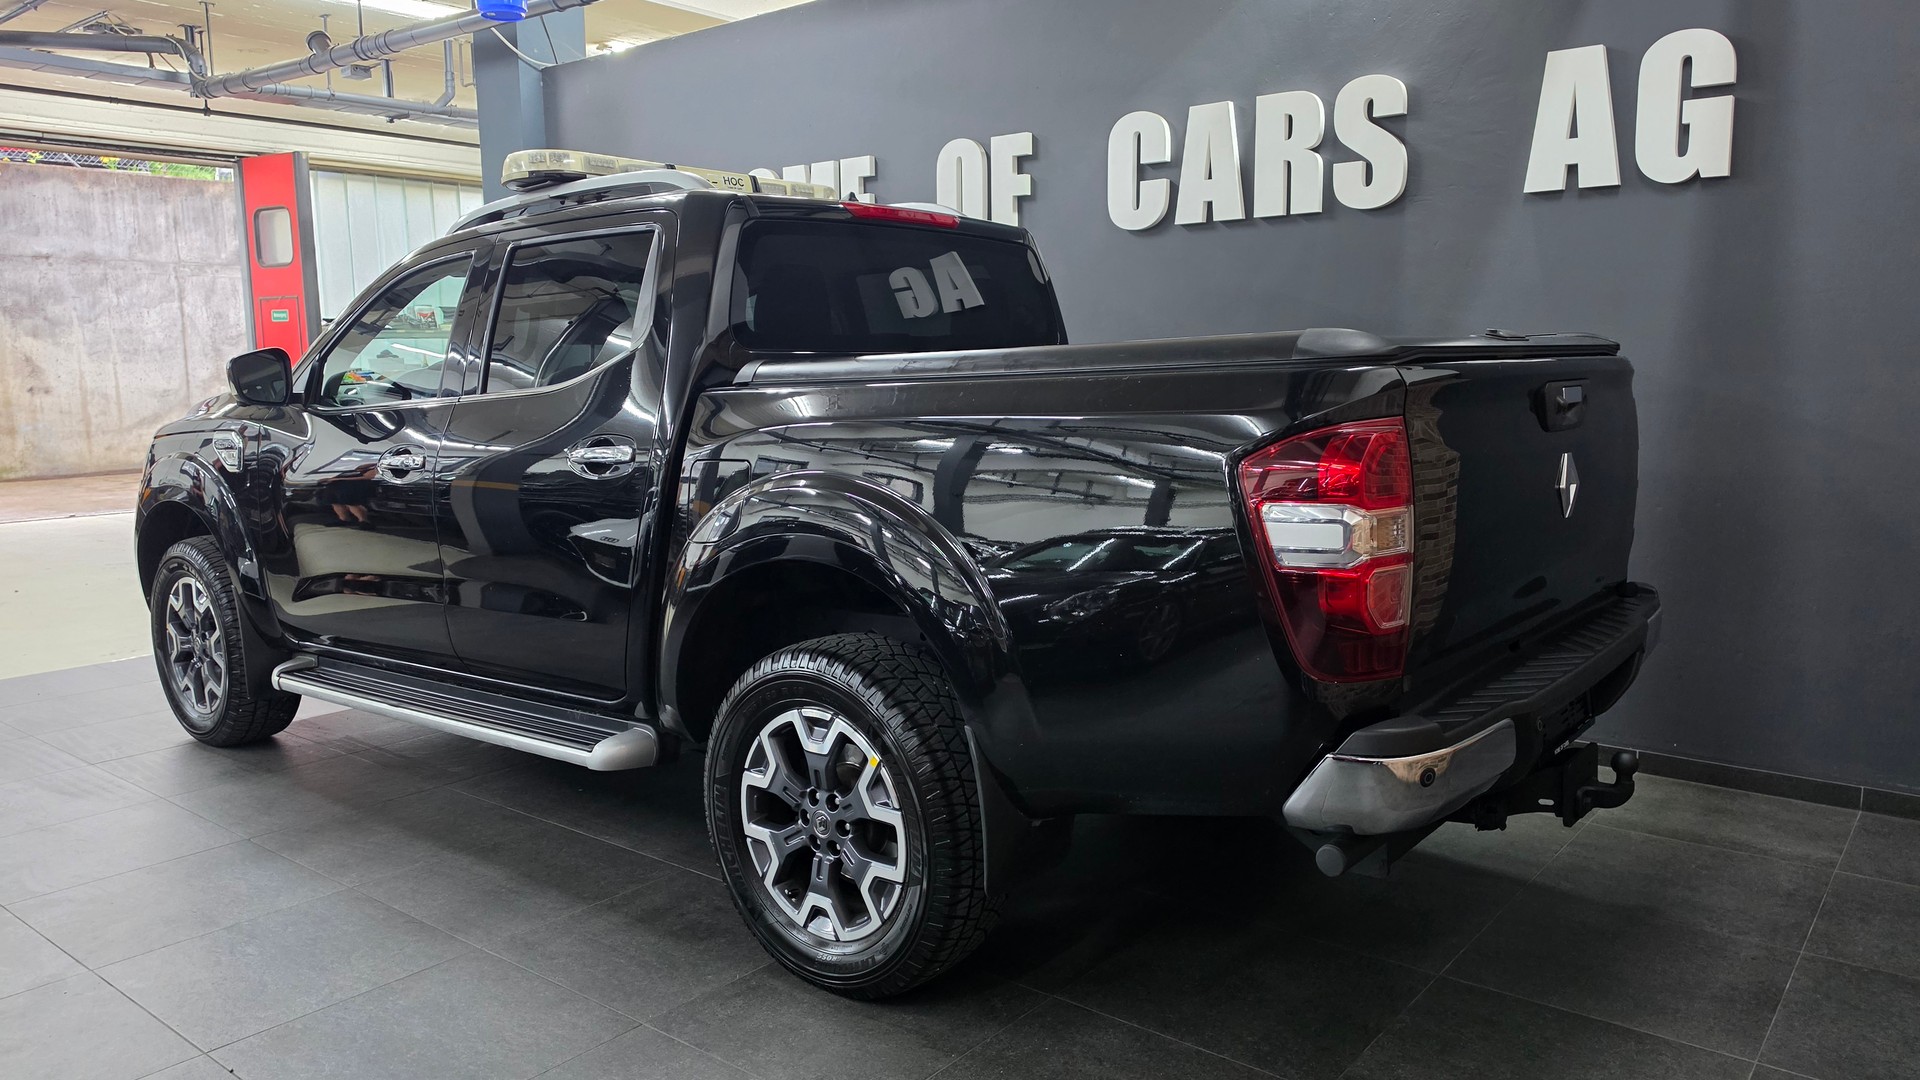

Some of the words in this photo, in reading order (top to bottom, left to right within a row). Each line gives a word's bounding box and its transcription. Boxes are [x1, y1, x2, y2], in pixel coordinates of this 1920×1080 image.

[723, 176, 744, 187] HOC
[936, 132, 1033, 227] OF
[1107, 74, 1408, 230] CARS
[1523, 28, 1737, 193] AG
